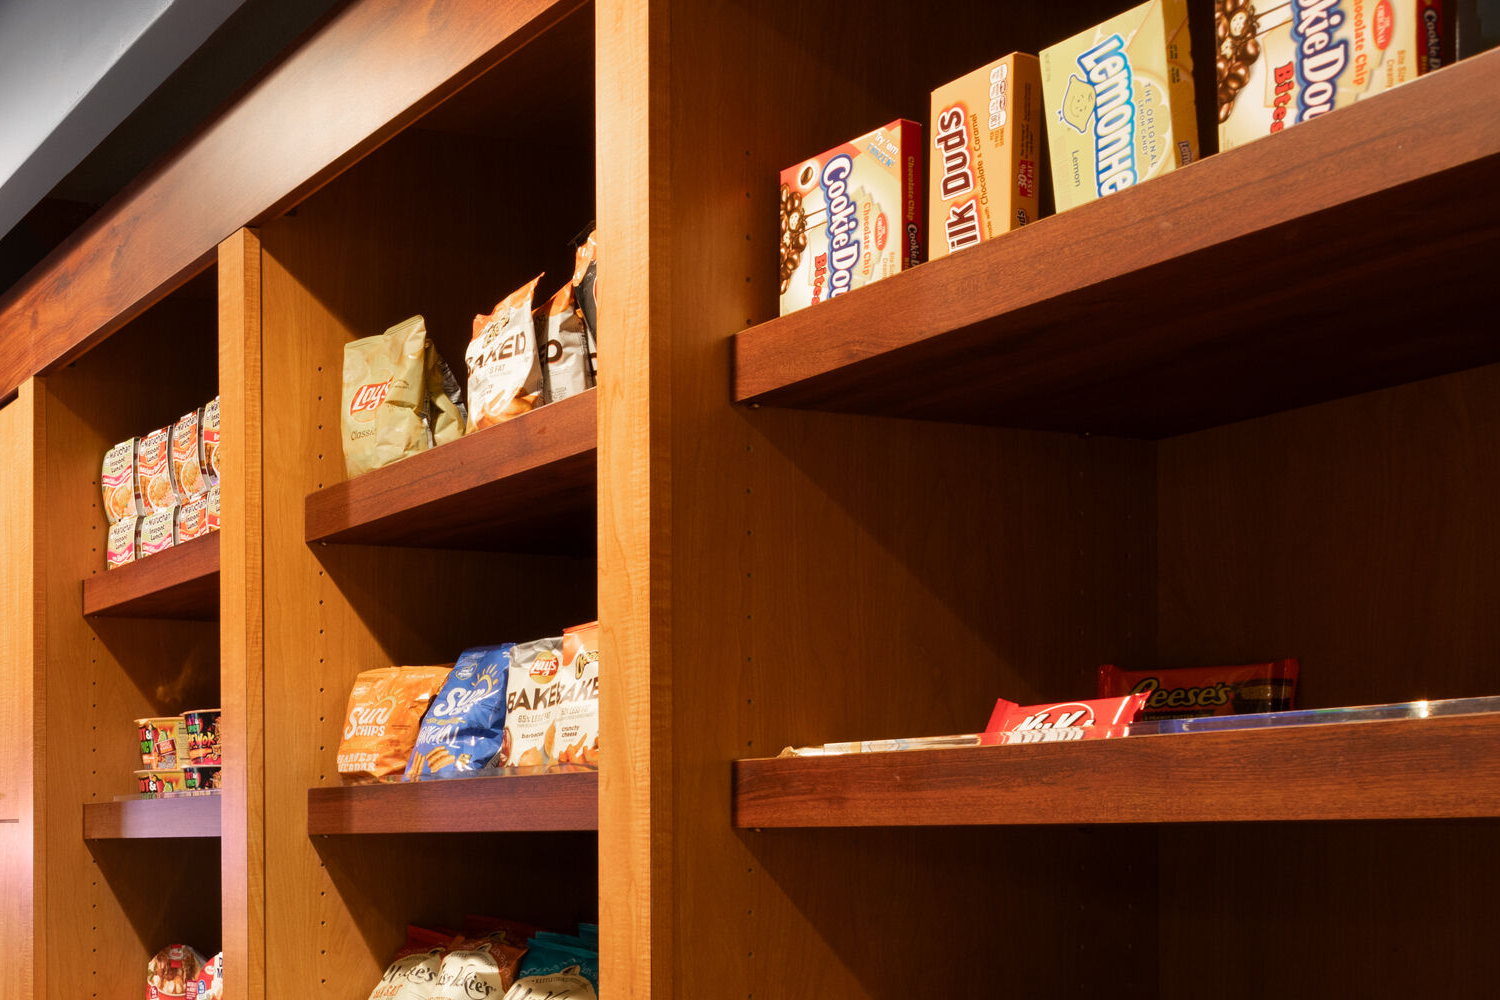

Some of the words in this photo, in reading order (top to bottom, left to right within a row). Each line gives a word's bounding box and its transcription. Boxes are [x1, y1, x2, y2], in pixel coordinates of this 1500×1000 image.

[1353, 53, 1368, 86] Chip
[1143, 82, 1153, 102] THE
[1138, 100, 1146, 127] LEMON
[874, 132, 885, 146] Try
[970, 113, 982, 152] Caramel
[1140, 128, 1149, 157] CANDY
[1146, 108, 1158, 168] ORIGINAL
[934, 106, 974, 201] Duds
[1071, 150, 1081, 187] Lemon
[980, 163, 989, 205] Chocolate
[862, 201, 872, 249] Chocolate
[946, 197, 981, 254] ilk
[811, 252, 828, 306] Bites
[863, 250, 872, 276] Chip
[350, 427, 375, 441] Classi
[344, 706, 390, 741] Sun
[354, 725, 386, 737] CHIPS
